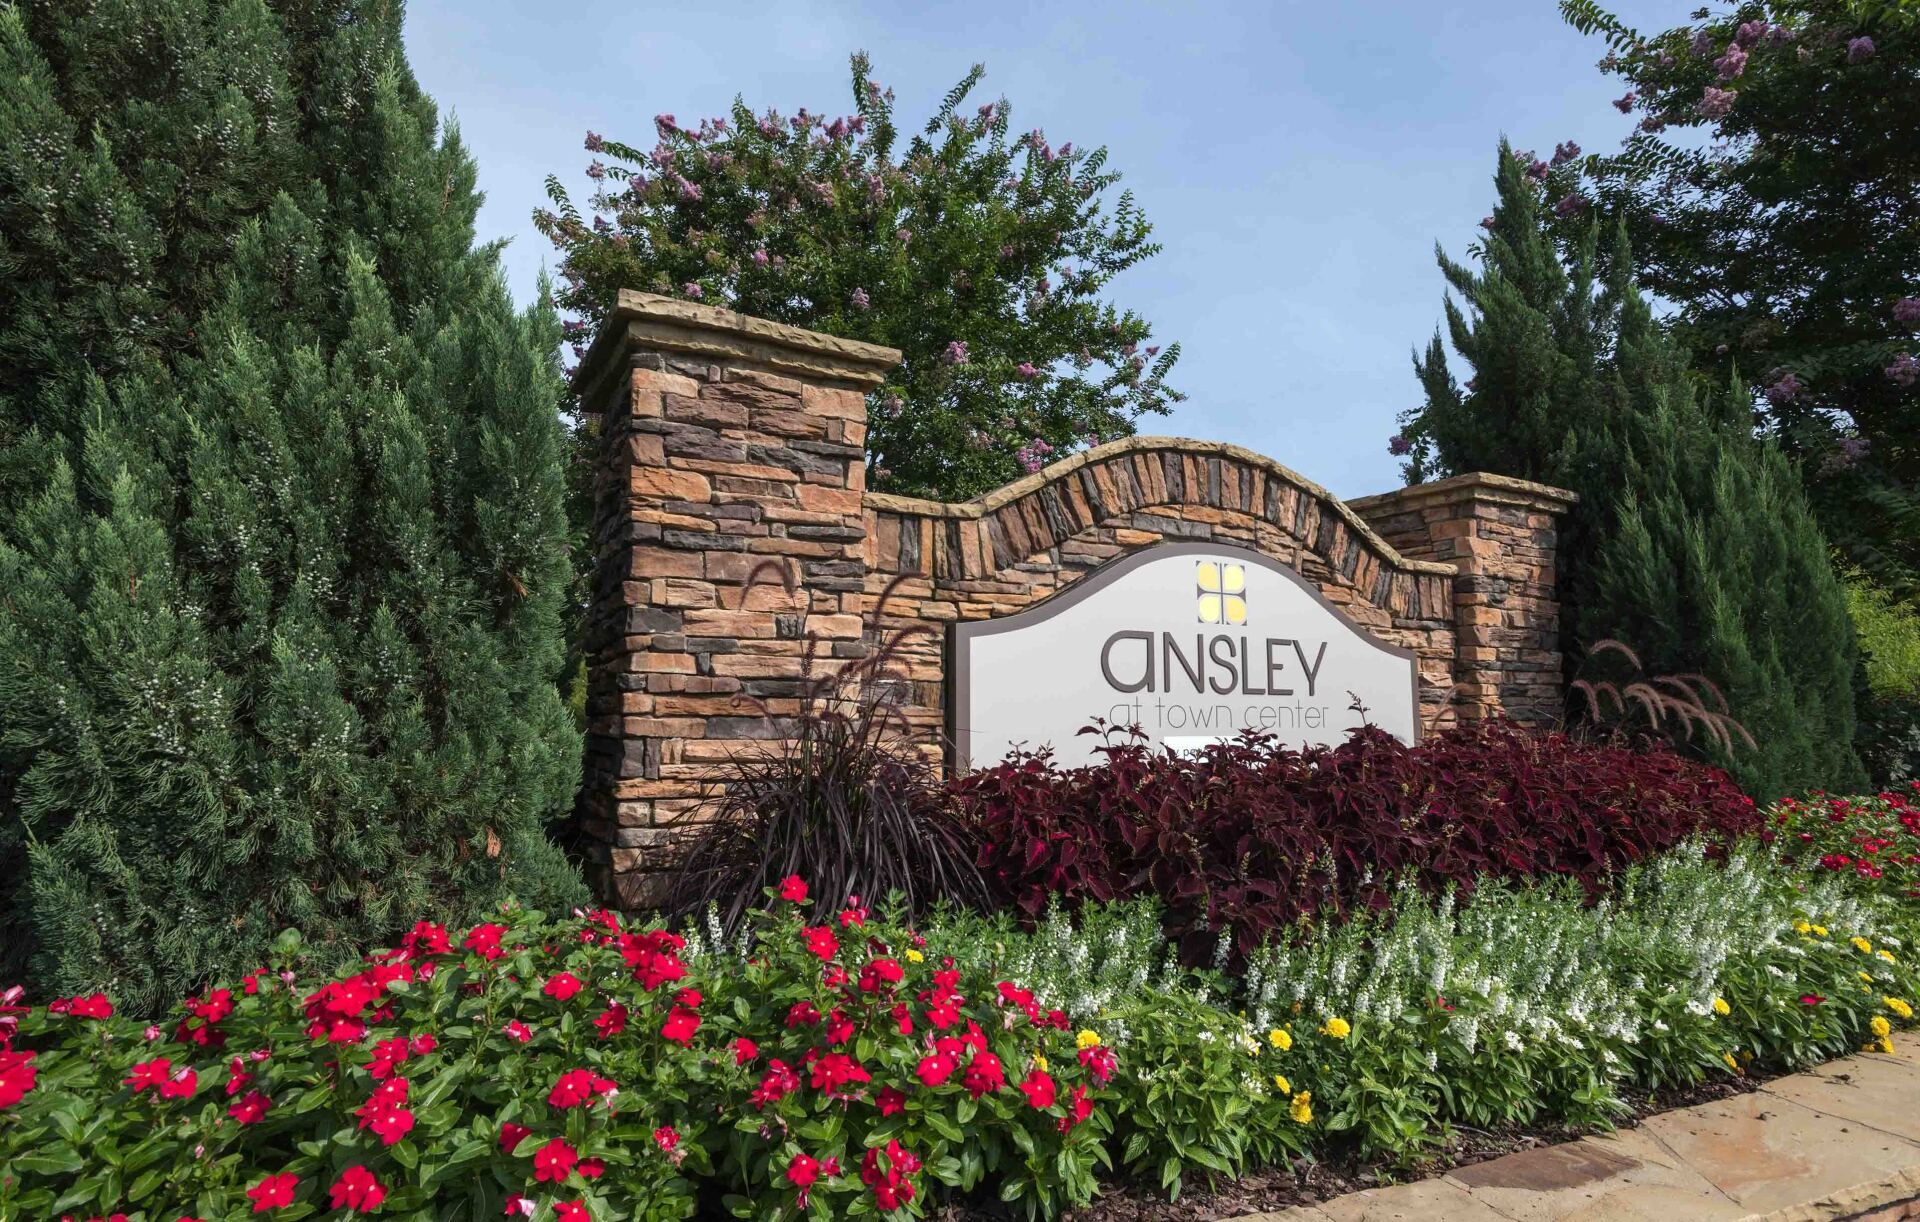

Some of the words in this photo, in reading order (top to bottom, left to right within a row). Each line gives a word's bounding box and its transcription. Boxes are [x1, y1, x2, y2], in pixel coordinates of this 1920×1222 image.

[1110, 696, 1142, 727] at
[1155, 697, 1232, 728] town
[1244, 699, 1329, 728] center
